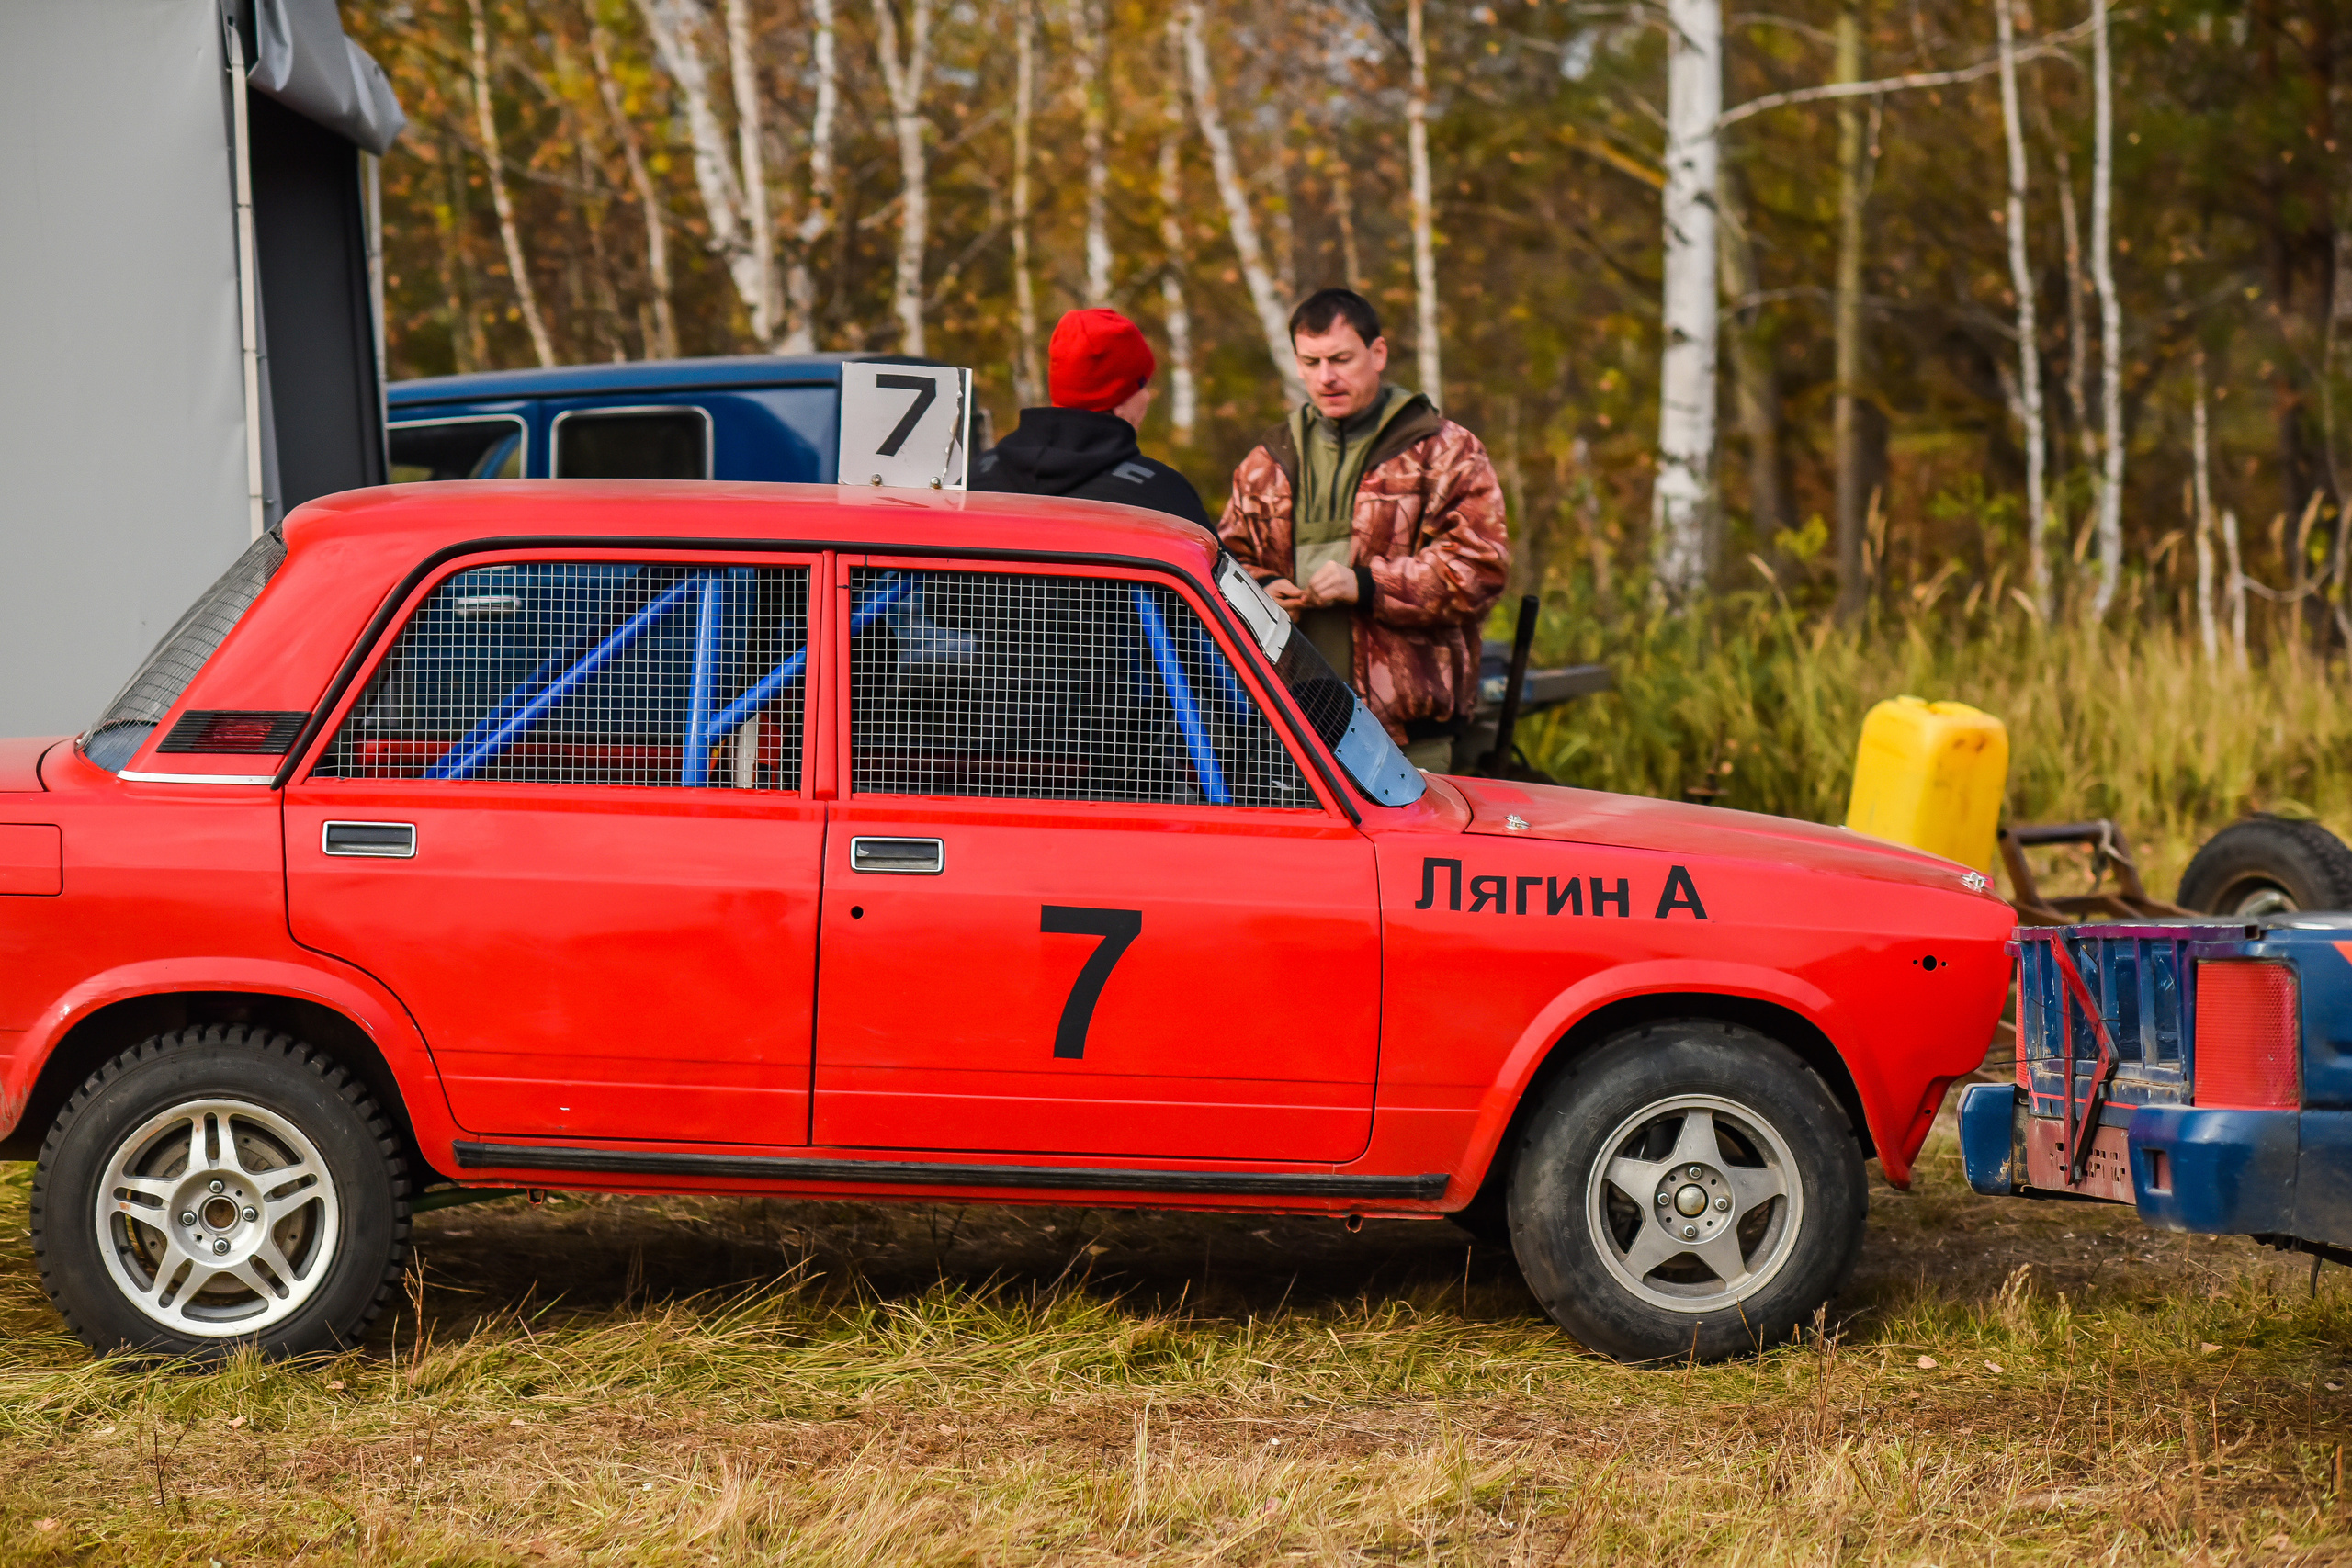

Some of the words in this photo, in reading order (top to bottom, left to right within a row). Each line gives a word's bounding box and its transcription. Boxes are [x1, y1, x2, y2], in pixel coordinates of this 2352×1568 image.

[876, 373, 937, 457] 7
[1415, 857, 1630, 918] Лягин
[1655, 865, 1708, 920] А
[1040, 905, 1143, 1060] 7
